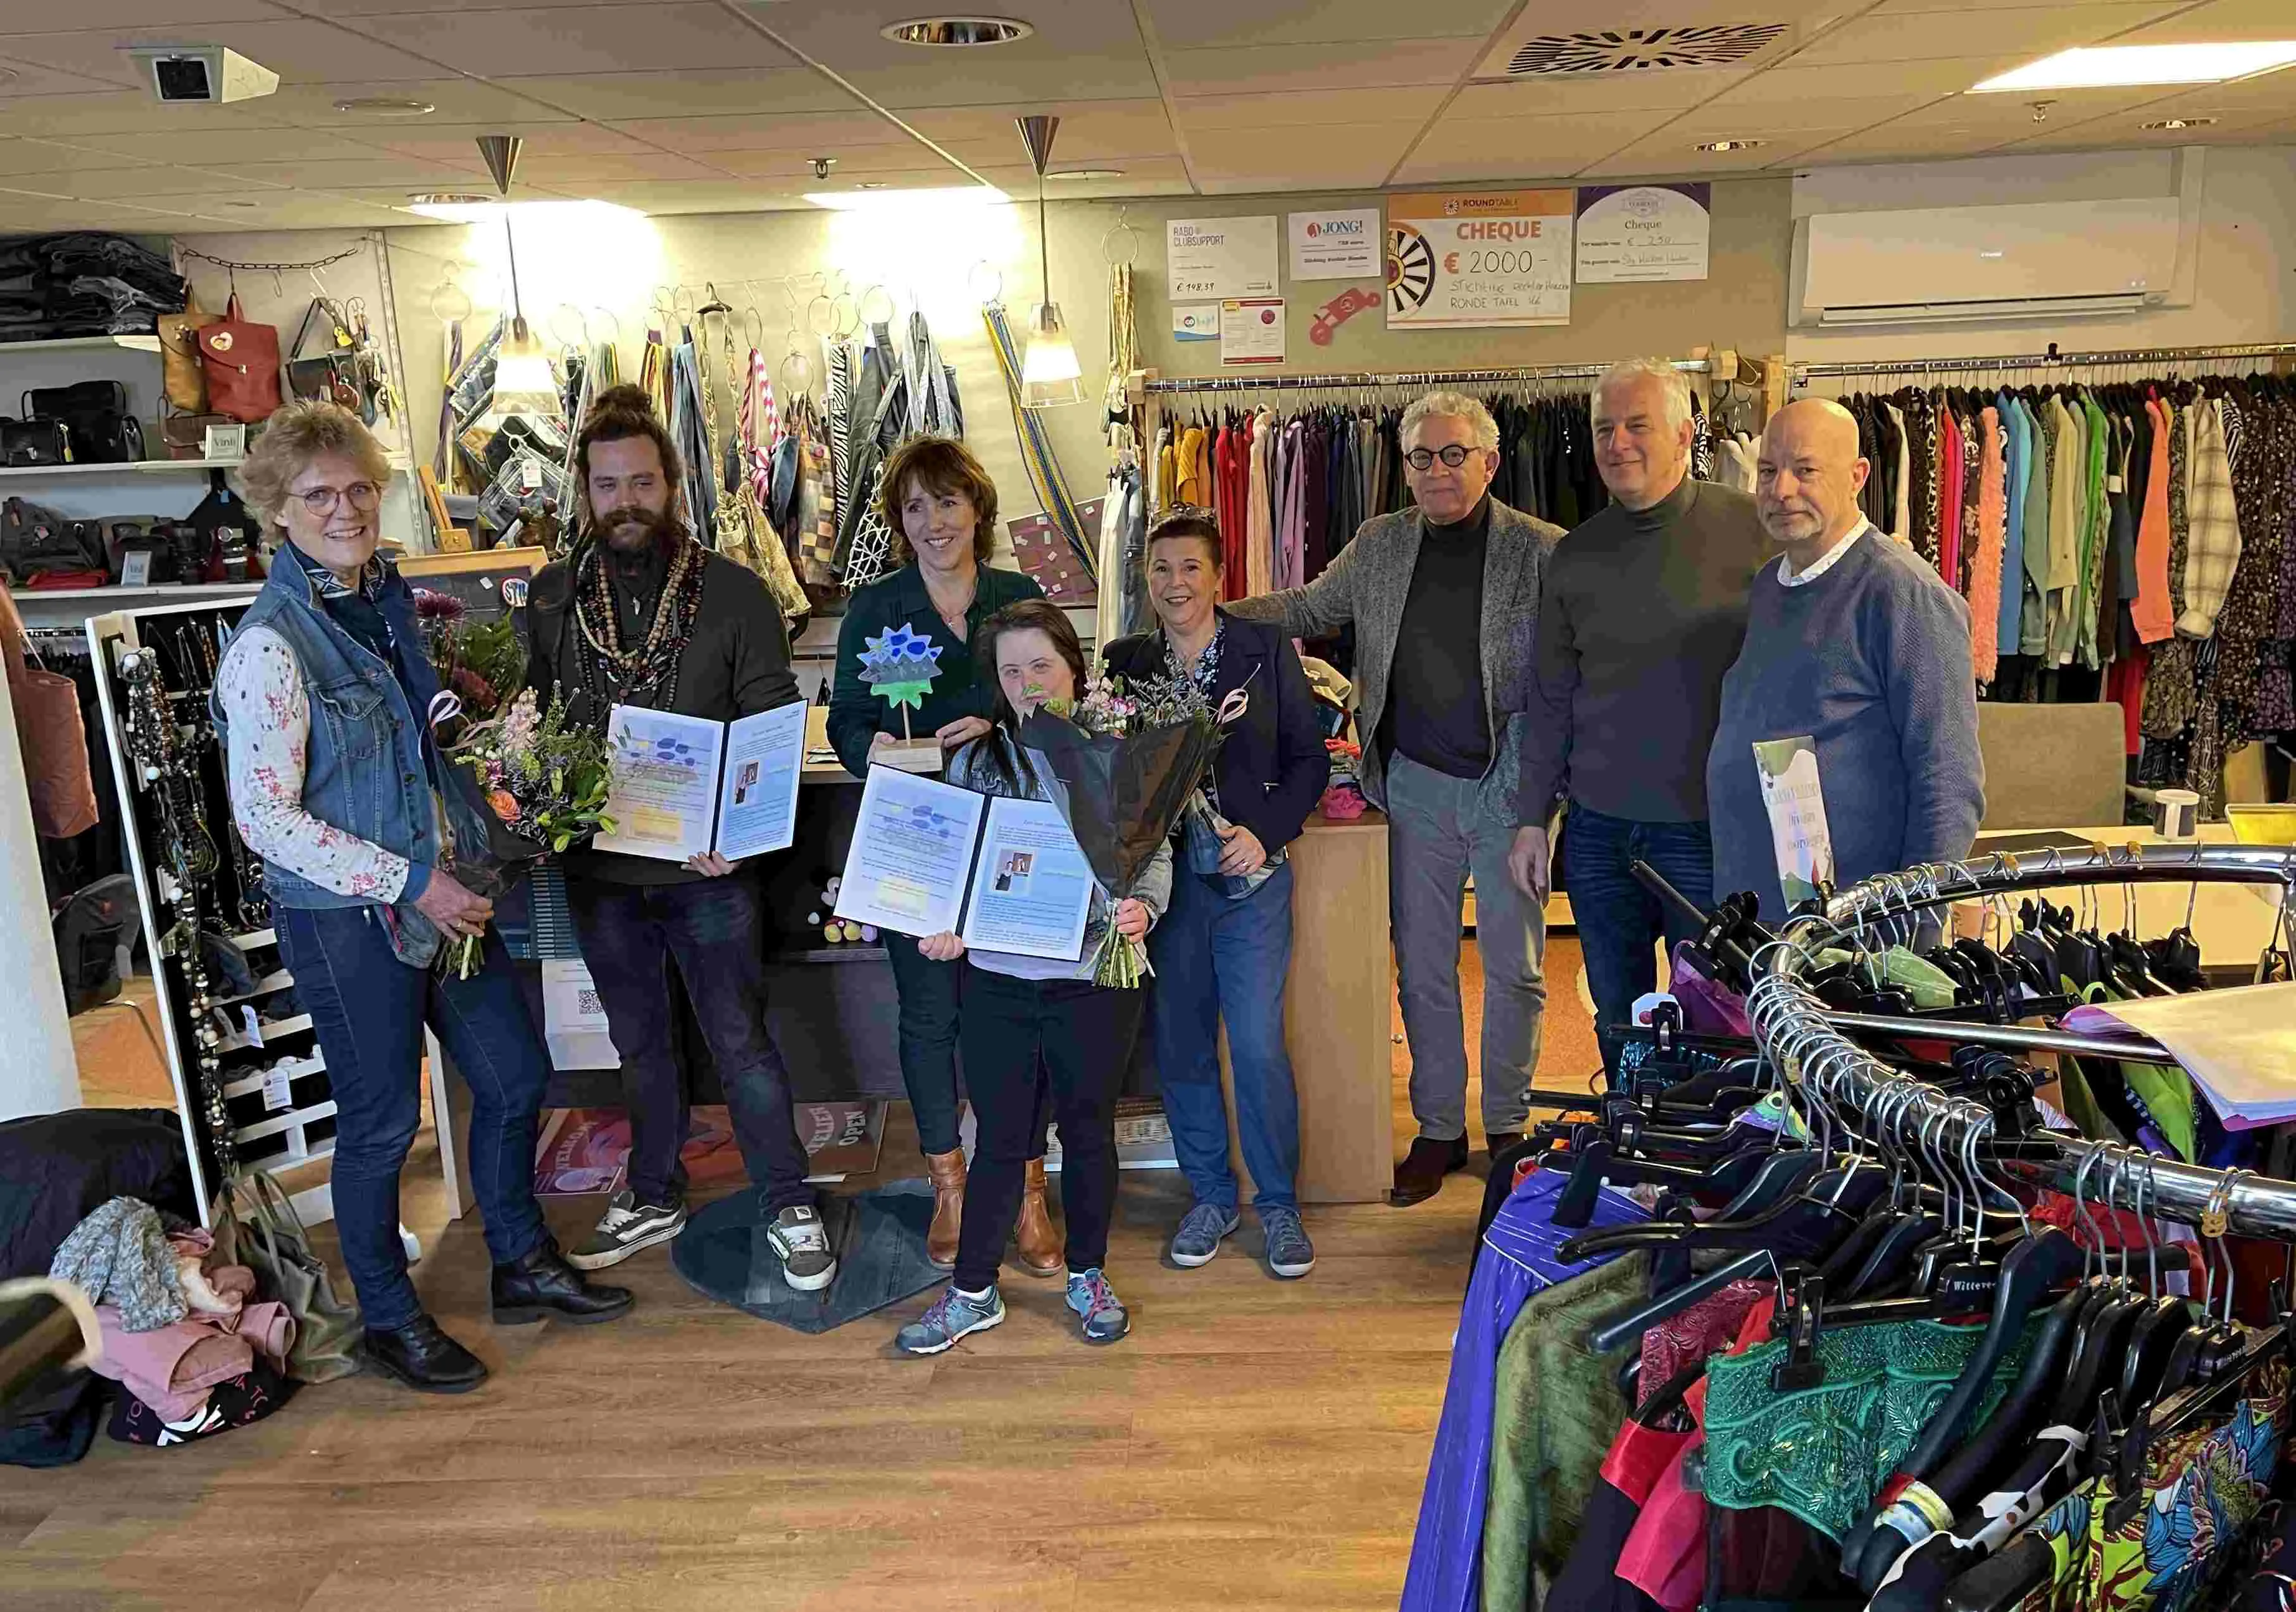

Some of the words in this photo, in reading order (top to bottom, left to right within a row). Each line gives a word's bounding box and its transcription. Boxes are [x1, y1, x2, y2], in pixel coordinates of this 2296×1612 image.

[1173, 226, 1194, 237] RABO
[1323, 220, 1363, 234] JONG!
[1457, 221, 1542, 242] CHEQUE
[1625, 219, 1662, 231] Cheque
[1173, 235, 1225, 247] CLUBSUPPORT
[1444, 252, 1460, 274] €
[1469, 251, 1532, 273] 2000
[1450, 296, 1487, 309] RONDE
[838, 1110, 866, 1146] OPEN
